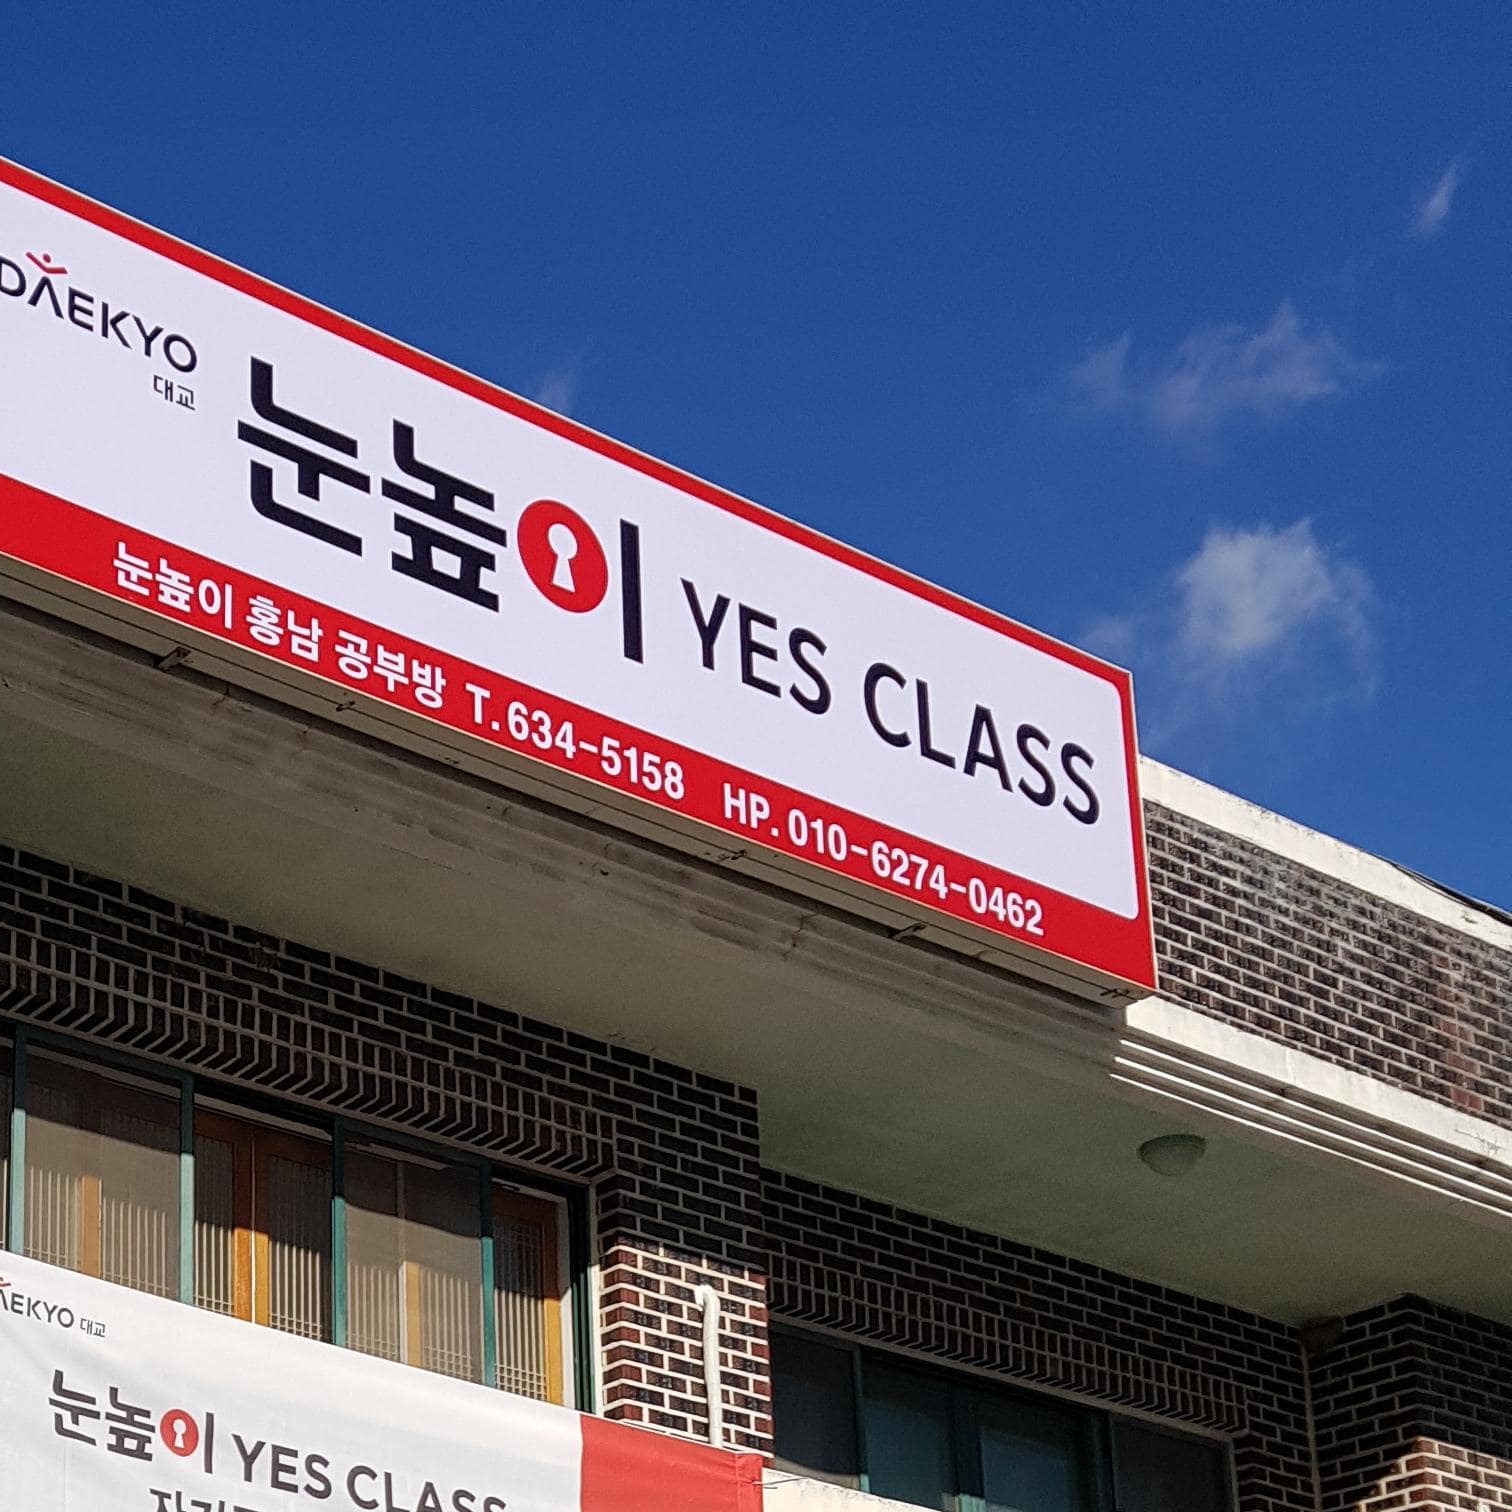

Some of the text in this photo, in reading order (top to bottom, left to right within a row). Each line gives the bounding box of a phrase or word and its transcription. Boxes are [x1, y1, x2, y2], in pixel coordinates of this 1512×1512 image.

[152, 374, 197, 411] 대교
[113, 541, 234, 630] 눈높이
[245, 596, 325, 661] 홍남
[333, 630, 447, 710] 공부방
[237, 355, 1102, 826] 눈높이 YES CLASS
[80, 1315, 107, 1339] 대교
[47, 1368, 215, 1475] 눈높이
[232, 1433, 333, 1499] YES
